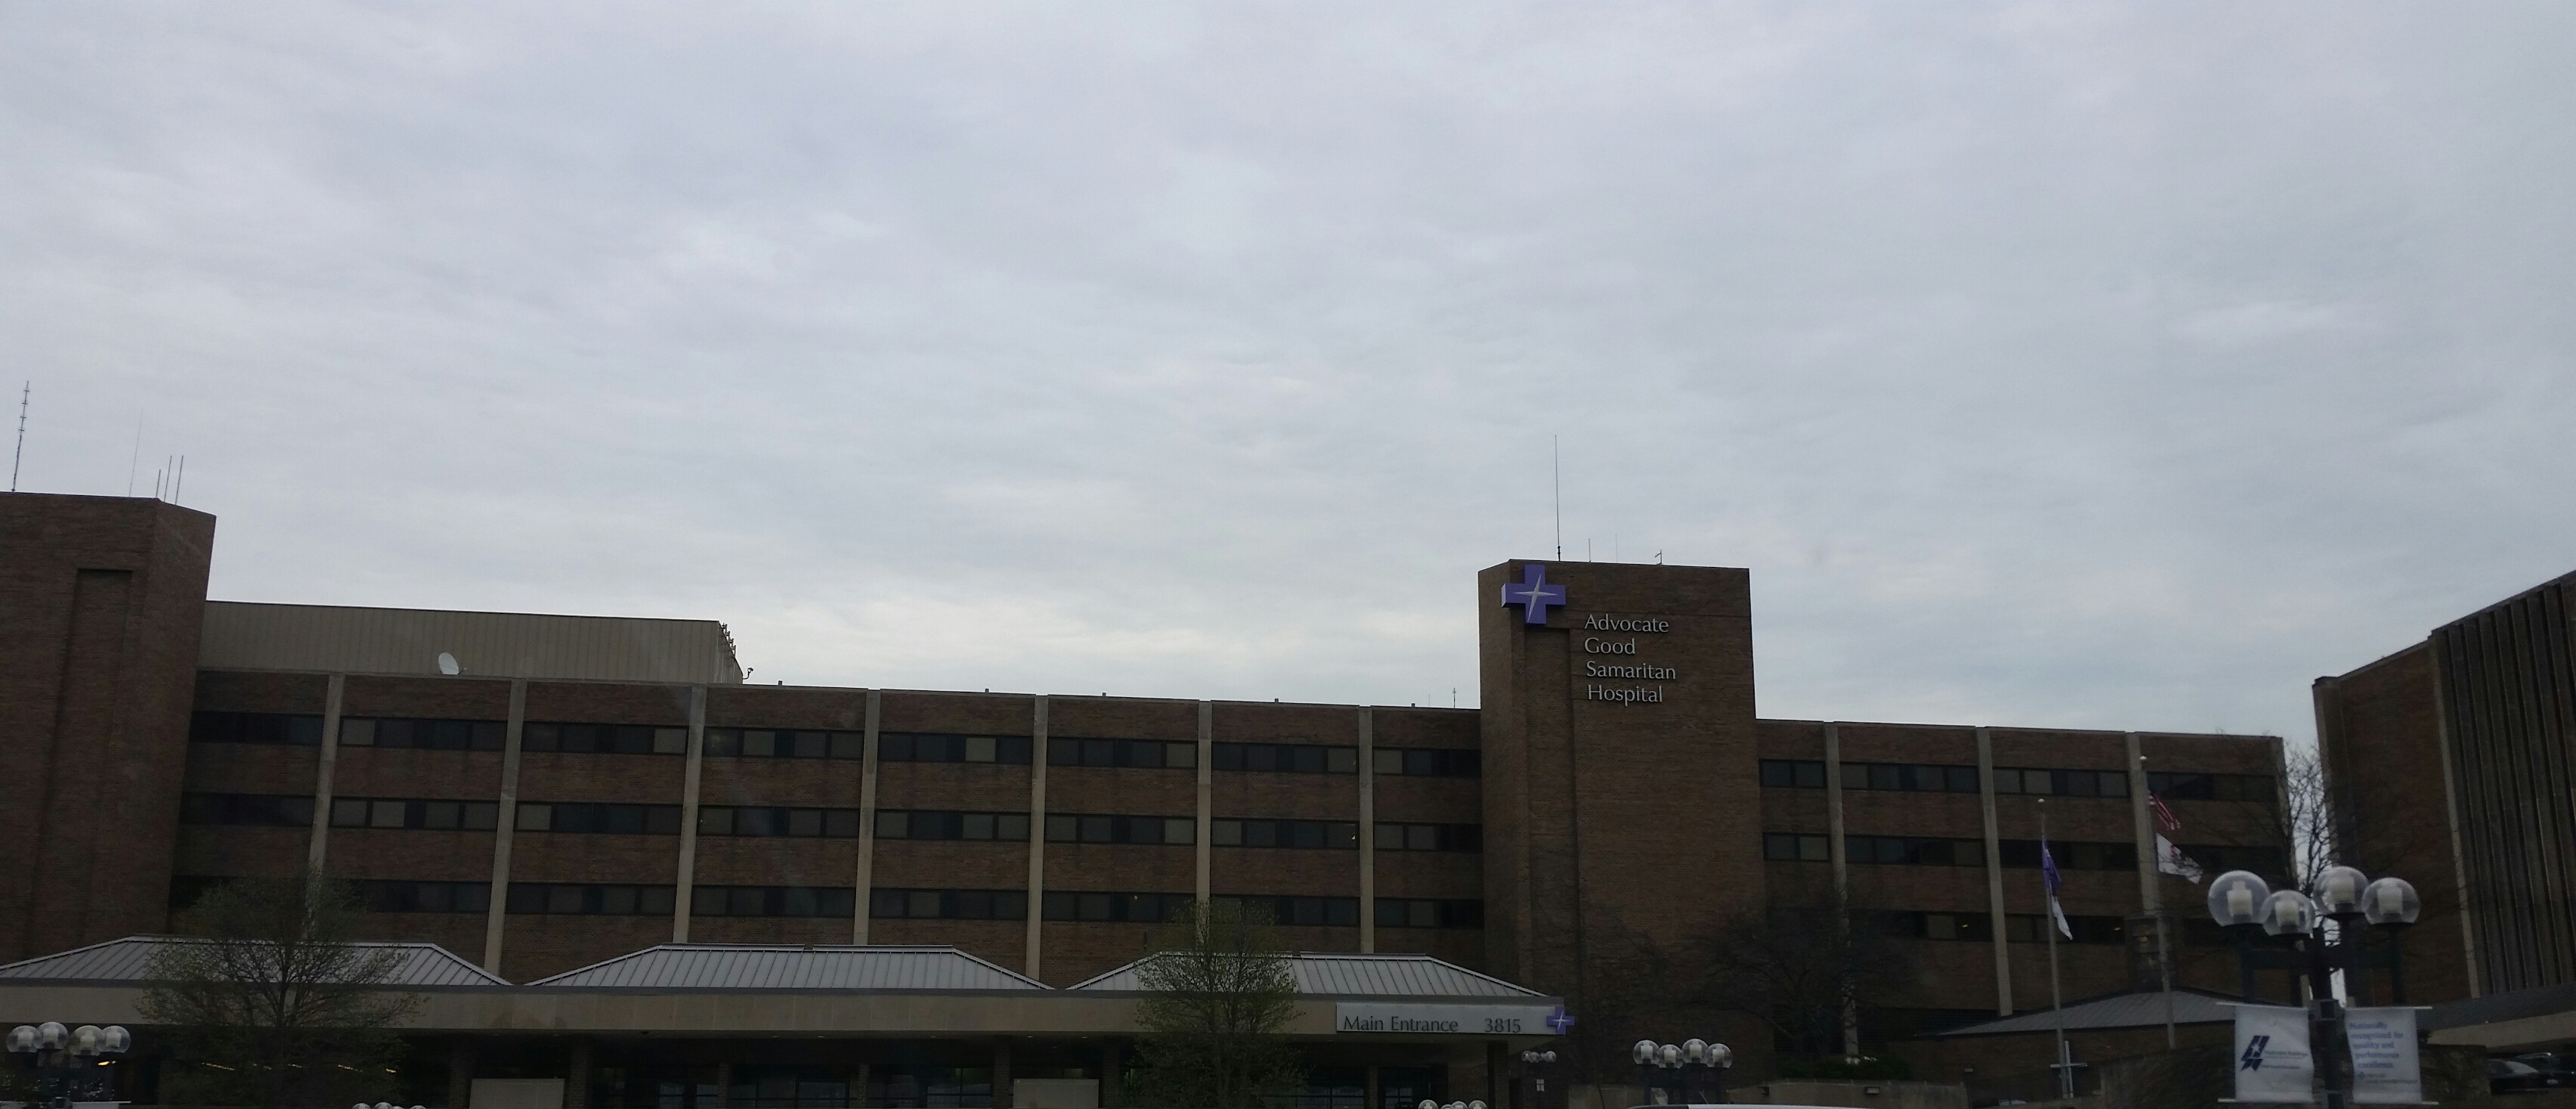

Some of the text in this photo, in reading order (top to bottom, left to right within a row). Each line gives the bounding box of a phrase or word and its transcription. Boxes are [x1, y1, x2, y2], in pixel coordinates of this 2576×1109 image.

[1584, 613, 1669, 633] Advocate
[1584, 637, 1636, 655] Good
[1586, 661, 1676, 680] Samaritan
[1588, 684, 1662, 707] Hospital
[1344, 1015, 1521, 1033] Main Entrance 3815
